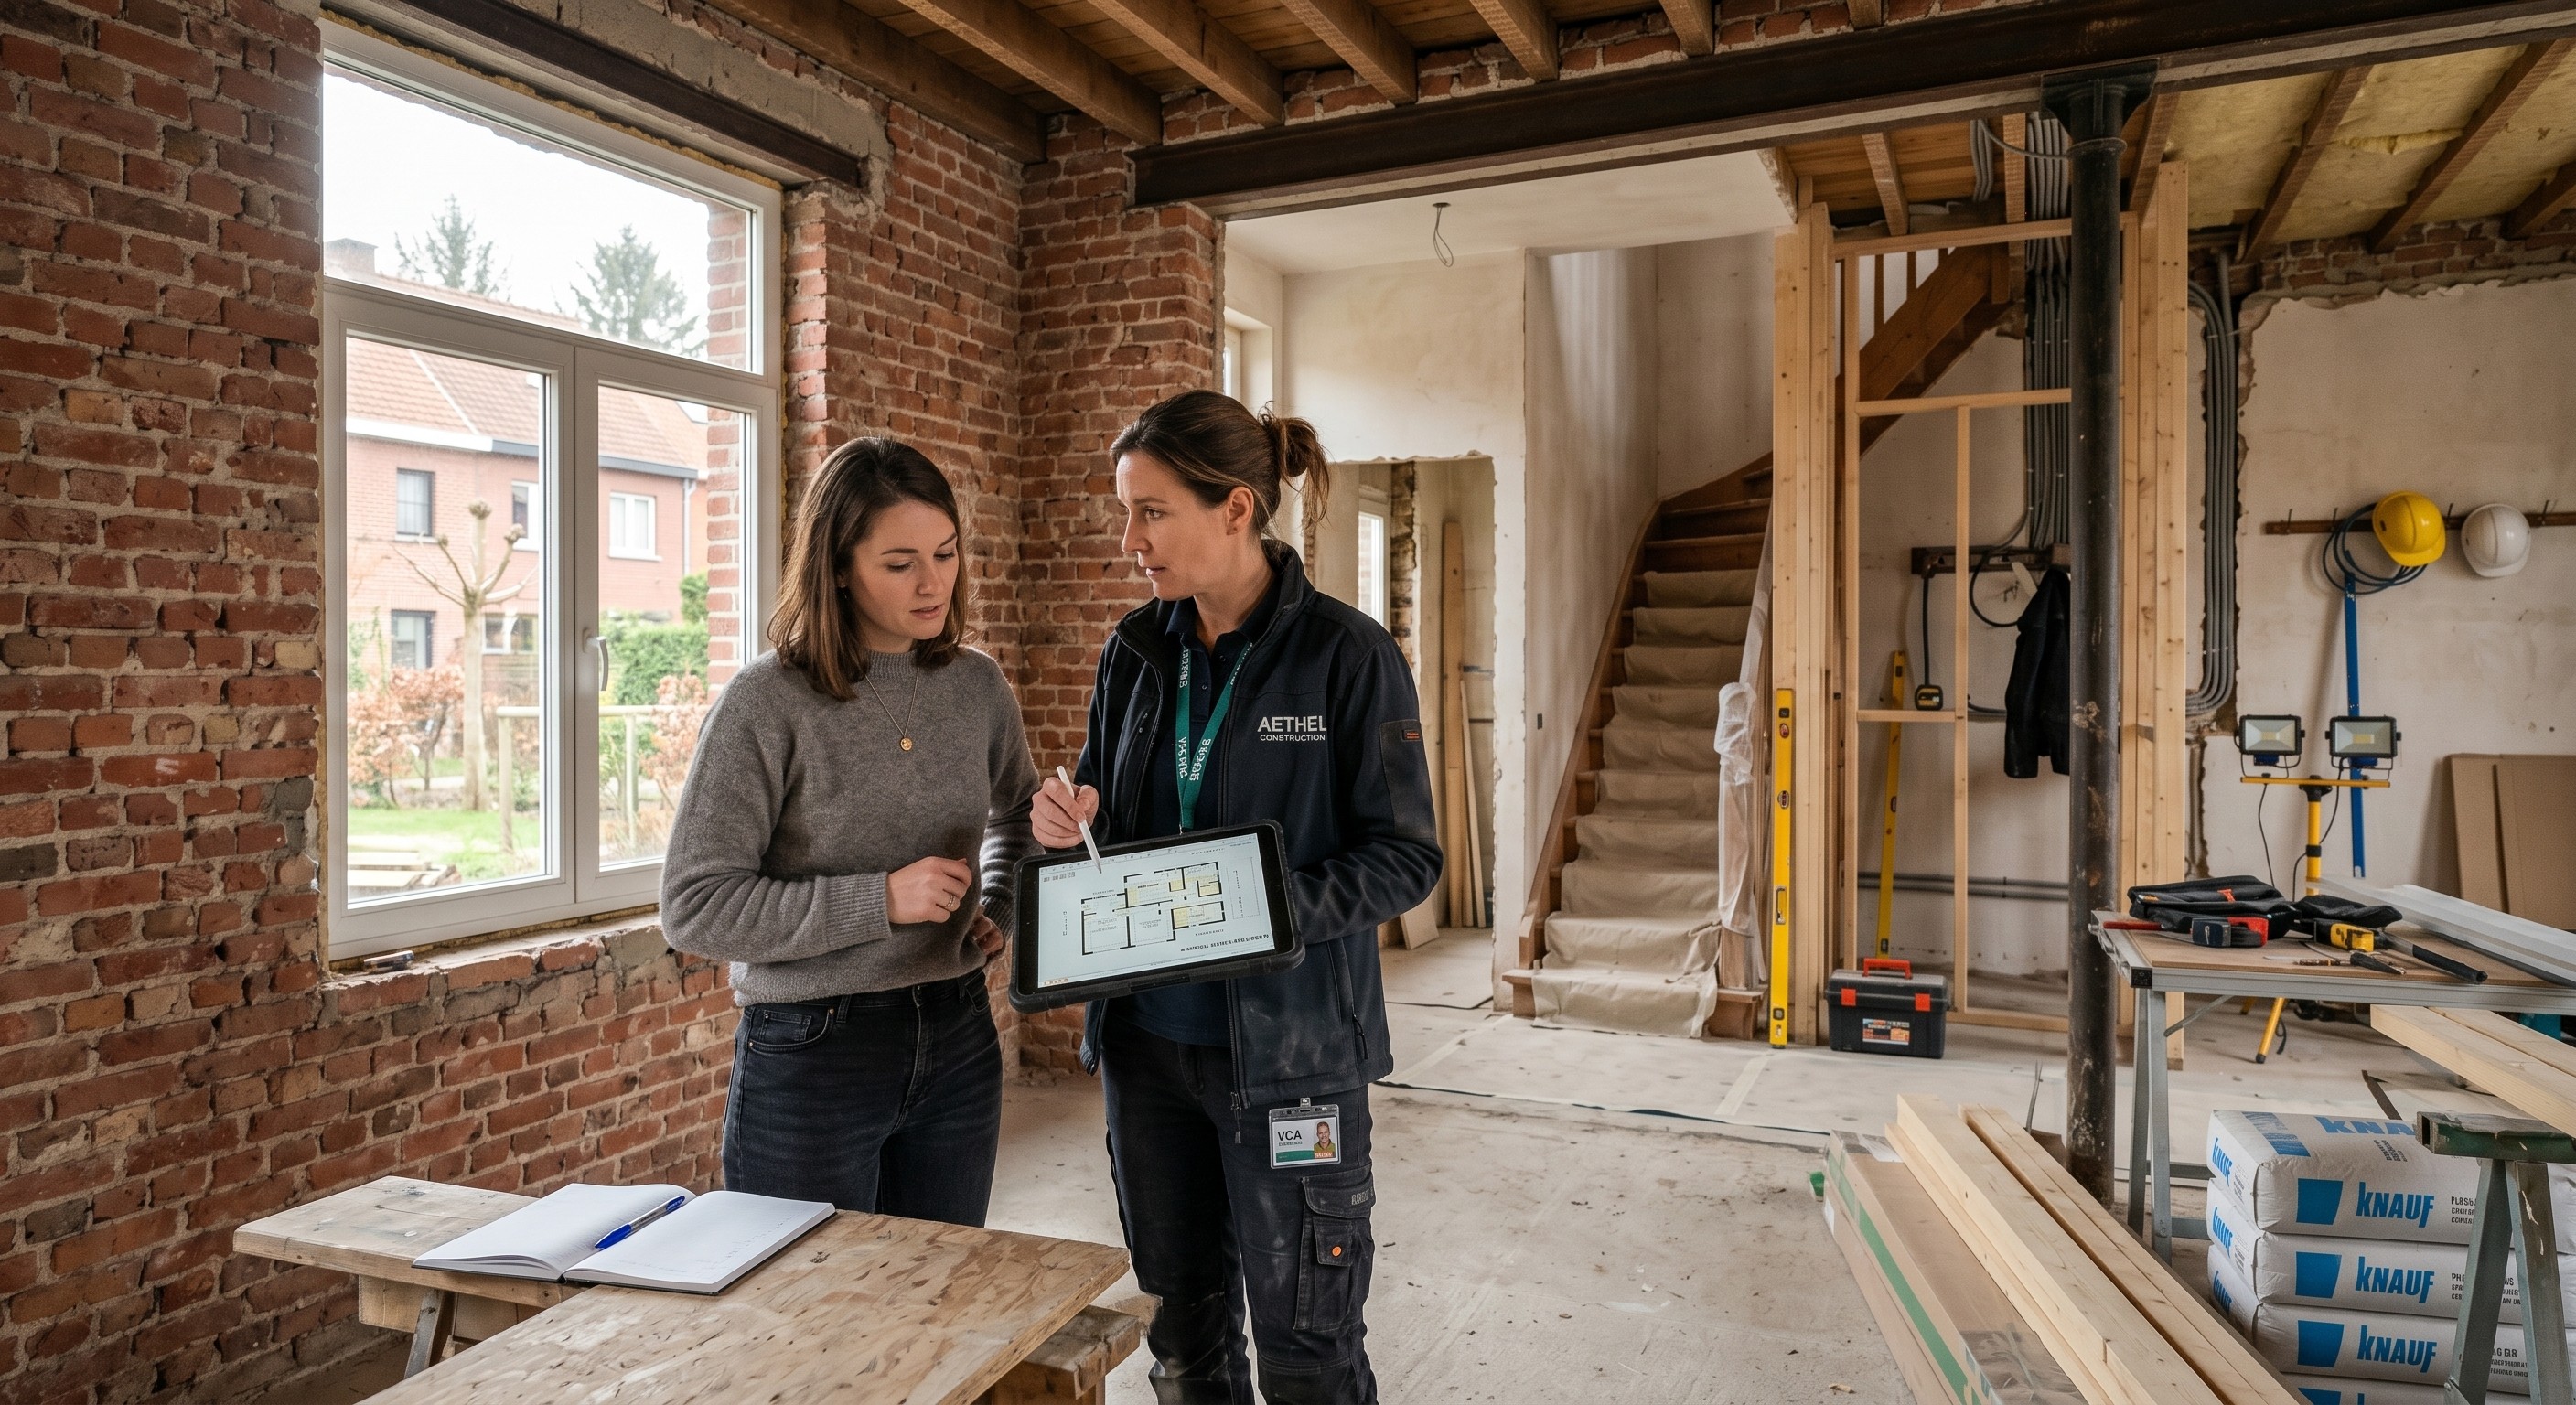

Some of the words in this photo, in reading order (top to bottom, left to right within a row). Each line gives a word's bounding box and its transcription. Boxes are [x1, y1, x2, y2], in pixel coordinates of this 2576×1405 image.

[1257, 715, 1327, 733] AETHEL
[1260, 734, 1326, 742] CONSTRUCTION
[1277, 1130, 1303, 1142] VCA
[2313, 1115, 2416, 1136] KNA
[2356, 1181, 2435, 1228] KNAUF
[2355, 1256, 2435, 1304] KNAUF
[2357, 1325, 2437, 1373] KNAUF
